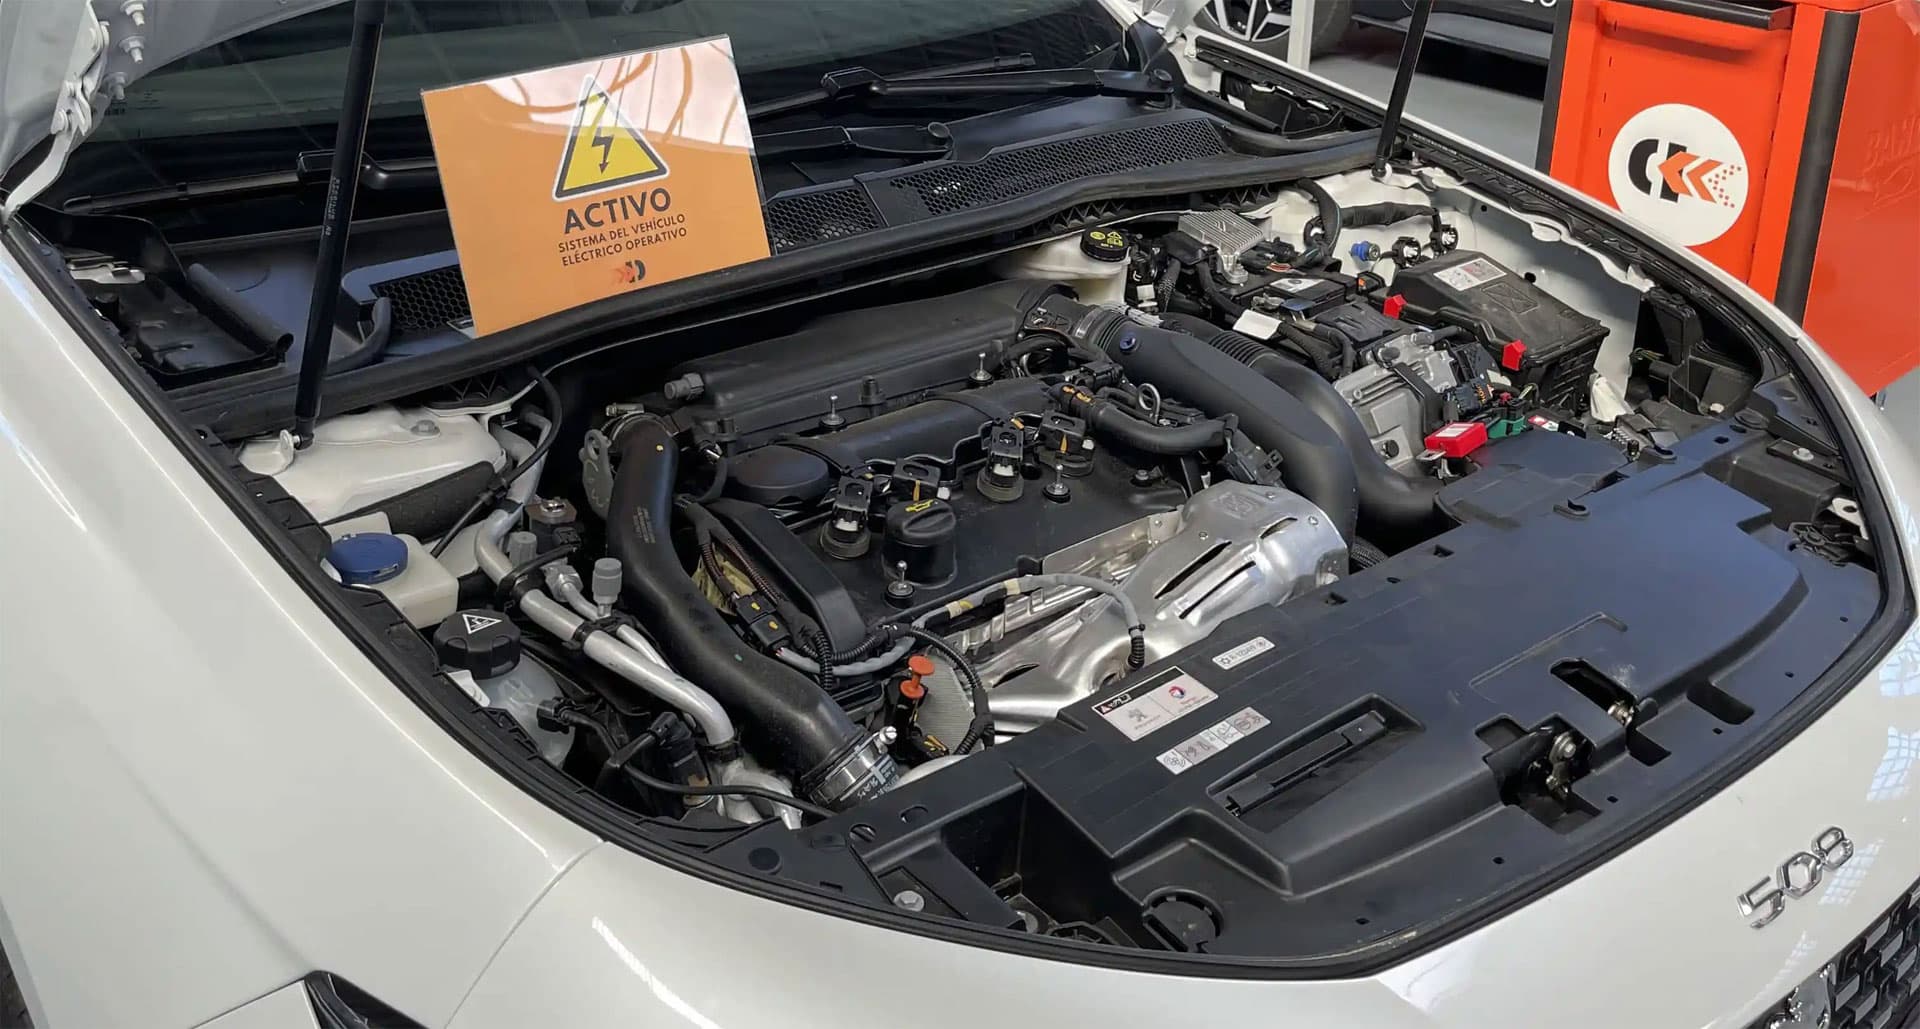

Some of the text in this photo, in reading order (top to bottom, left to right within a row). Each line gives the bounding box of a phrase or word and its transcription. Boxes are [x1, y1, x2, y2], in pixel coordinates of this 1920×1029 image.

[558, 213, 686, 253] SISTEMA DEL VEHÍCULO
[564, 187, 671, 235] ACTIVO
[561, 227, 687, 267] ELÉCTRICO OPERATIVO
[1736, 825, 1854, 929] 508
